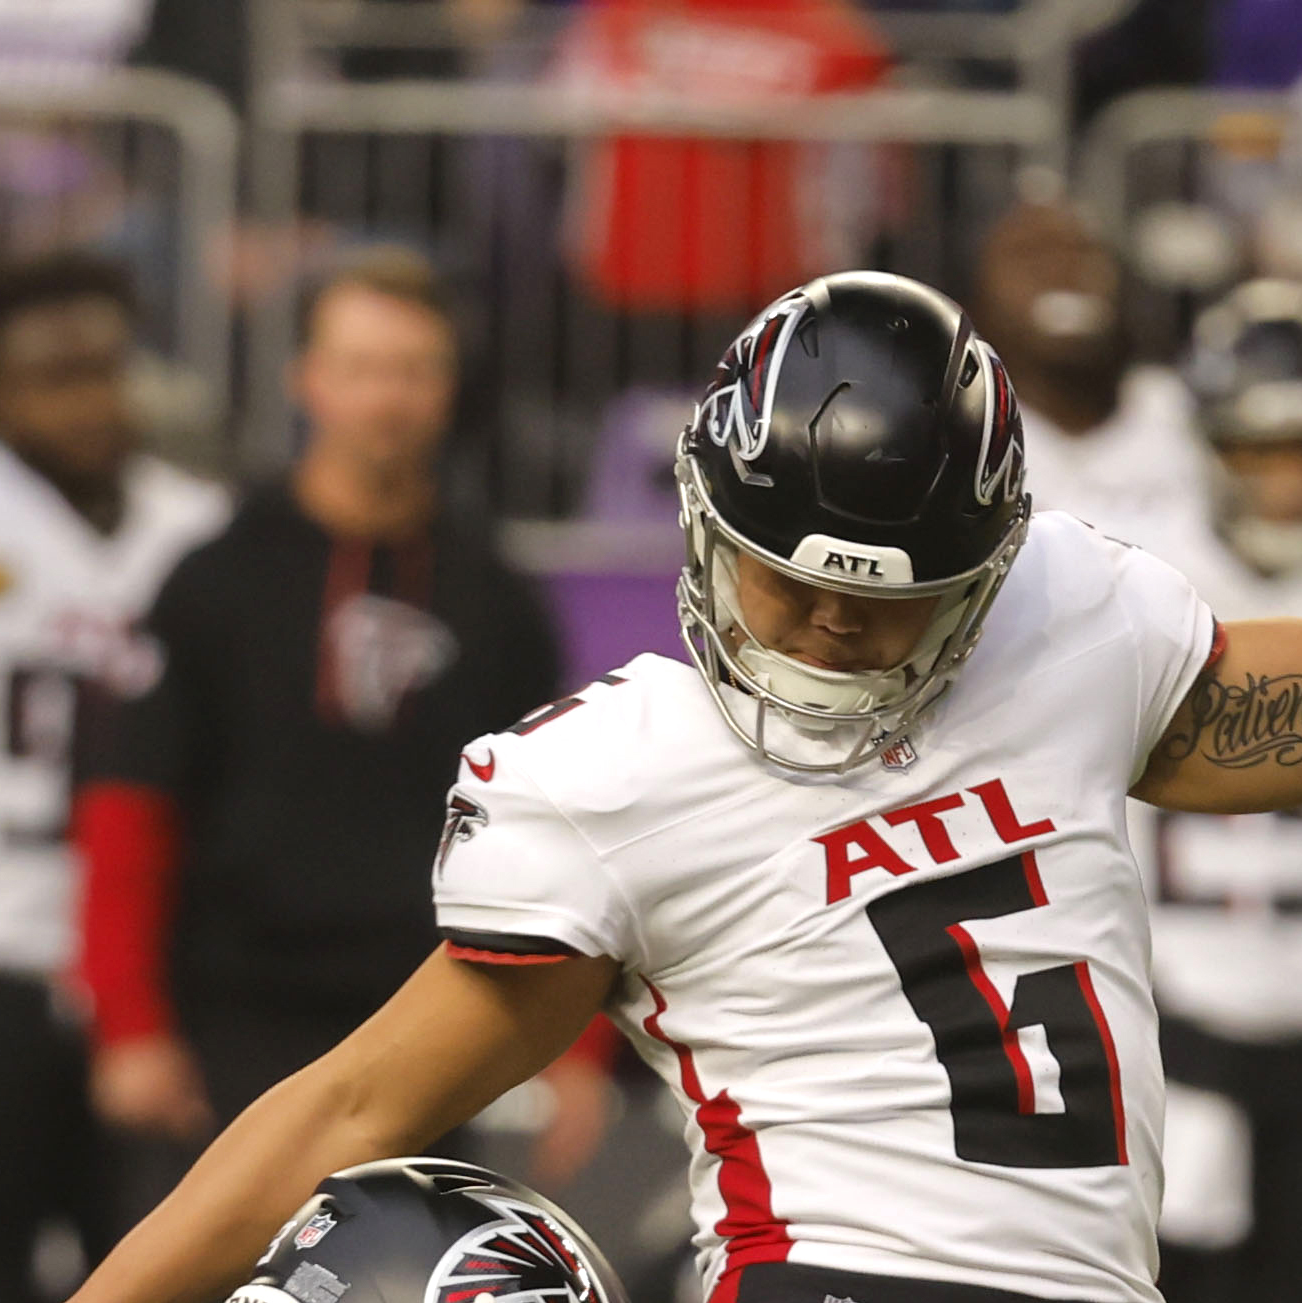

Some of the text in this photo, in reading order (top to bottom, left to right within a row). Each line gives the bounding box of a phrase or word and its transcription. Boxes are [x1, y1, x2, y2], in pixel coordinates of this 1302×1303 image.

[822, 551, 884, 577] ATL
[882, 742, 914, 765] NFL
[813, 778, 1056, 906] ATL
[866, 850, 1129, 1169] 6
